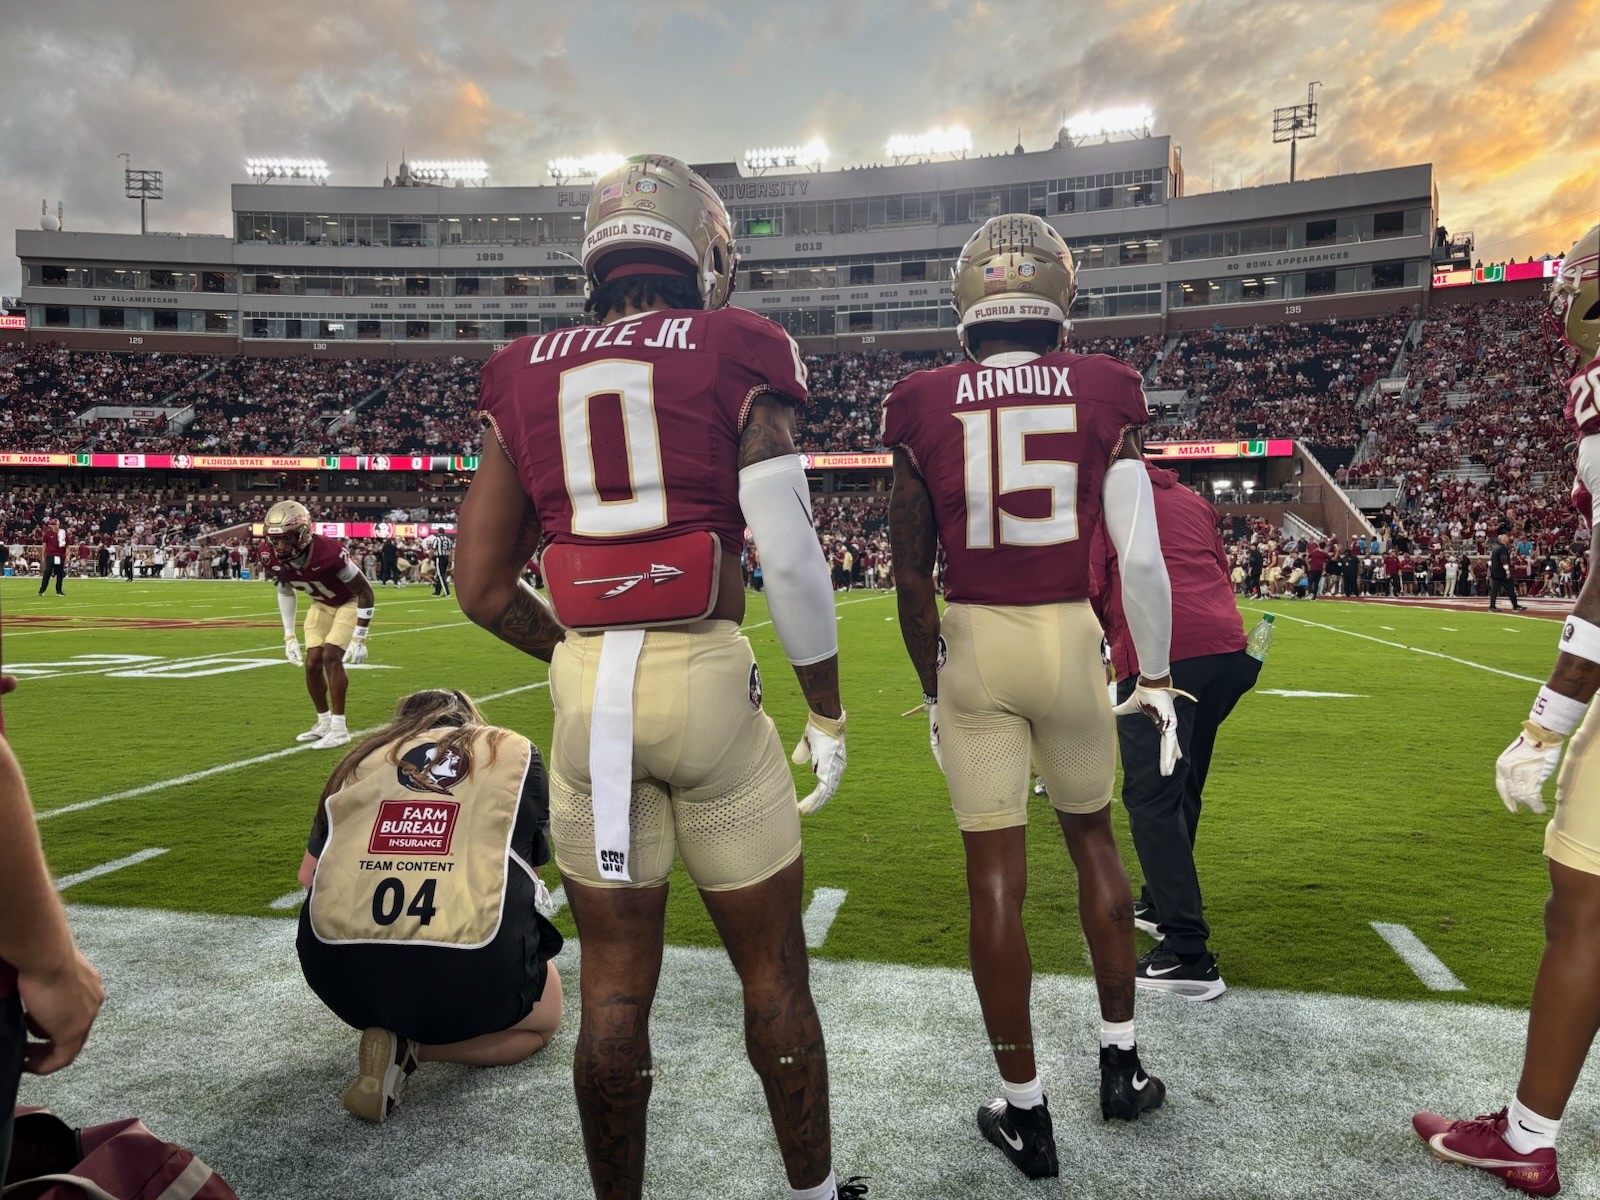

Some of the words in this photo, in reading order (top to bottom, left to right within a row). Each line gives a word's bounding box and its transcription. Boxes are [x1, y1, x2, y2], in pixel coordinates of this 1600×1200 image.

[711, 180, 809, 200] NIVERSITY
[587, 224, 628, 248] FLORIDA
[632, 224, 673, 242] STATE
[794, 241, 823, 251] 2013
[1246, 259, 1273, 269] BOWL
[1276, 251, 1349, 266] APPEARANCES
[111, 295, 179, 304] ALL-AMERICANS
[974, 305, 1016, 319] FLORIDA
[1019, 304, 1050, 316] STATE
[1284, 305, 1302, 315] 135
[529, 321, 643, 364] LITTLE
[643, 317, 697, 350] JR.
[955, 365, 1074, 404] ARNOUX
[558, 358, 669, 537] 0
[1178, 446, 1216, 454] MIAMI
[823, 457, 859, 465] FLORIDA
[861, 456, 888, 464] STATE
[950, 403, 1079, 549] 15
[402, 806, 448, 821] FARM
[380, 820, 447, 835] BUREAU
[388, 838, 442, 849] INSURANCE
[359, 860, 393, 871] TEAM
[396, 861, 455, 872] CONTENT
[372, 877, 437, 926] 04
